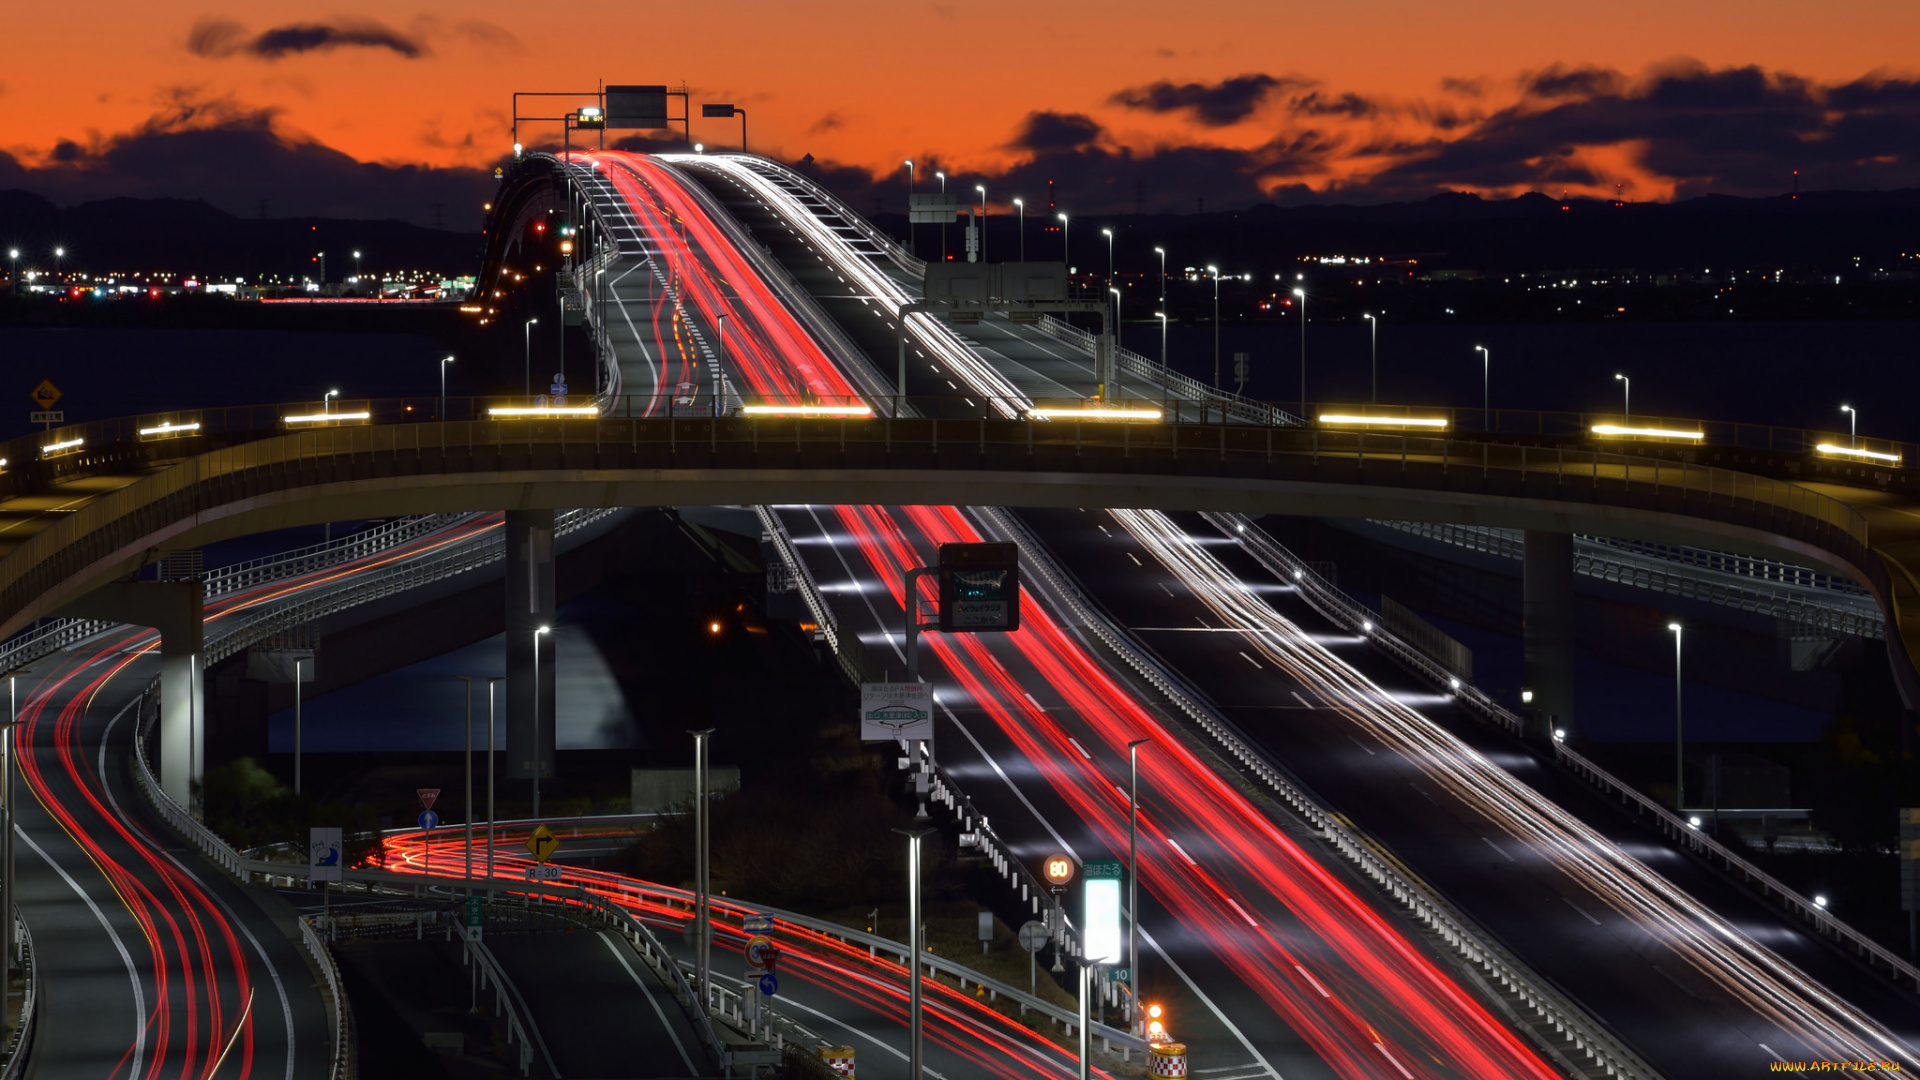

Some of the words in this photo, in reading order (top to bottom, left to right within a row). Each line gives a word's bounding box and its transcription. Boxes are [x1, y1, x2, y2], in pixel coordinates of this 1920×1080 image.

[1049, 860, 1068, 878] 80
[1083, 863, 1121, 876] 海ほたる
[1114, 969, 1128, 980] 10
